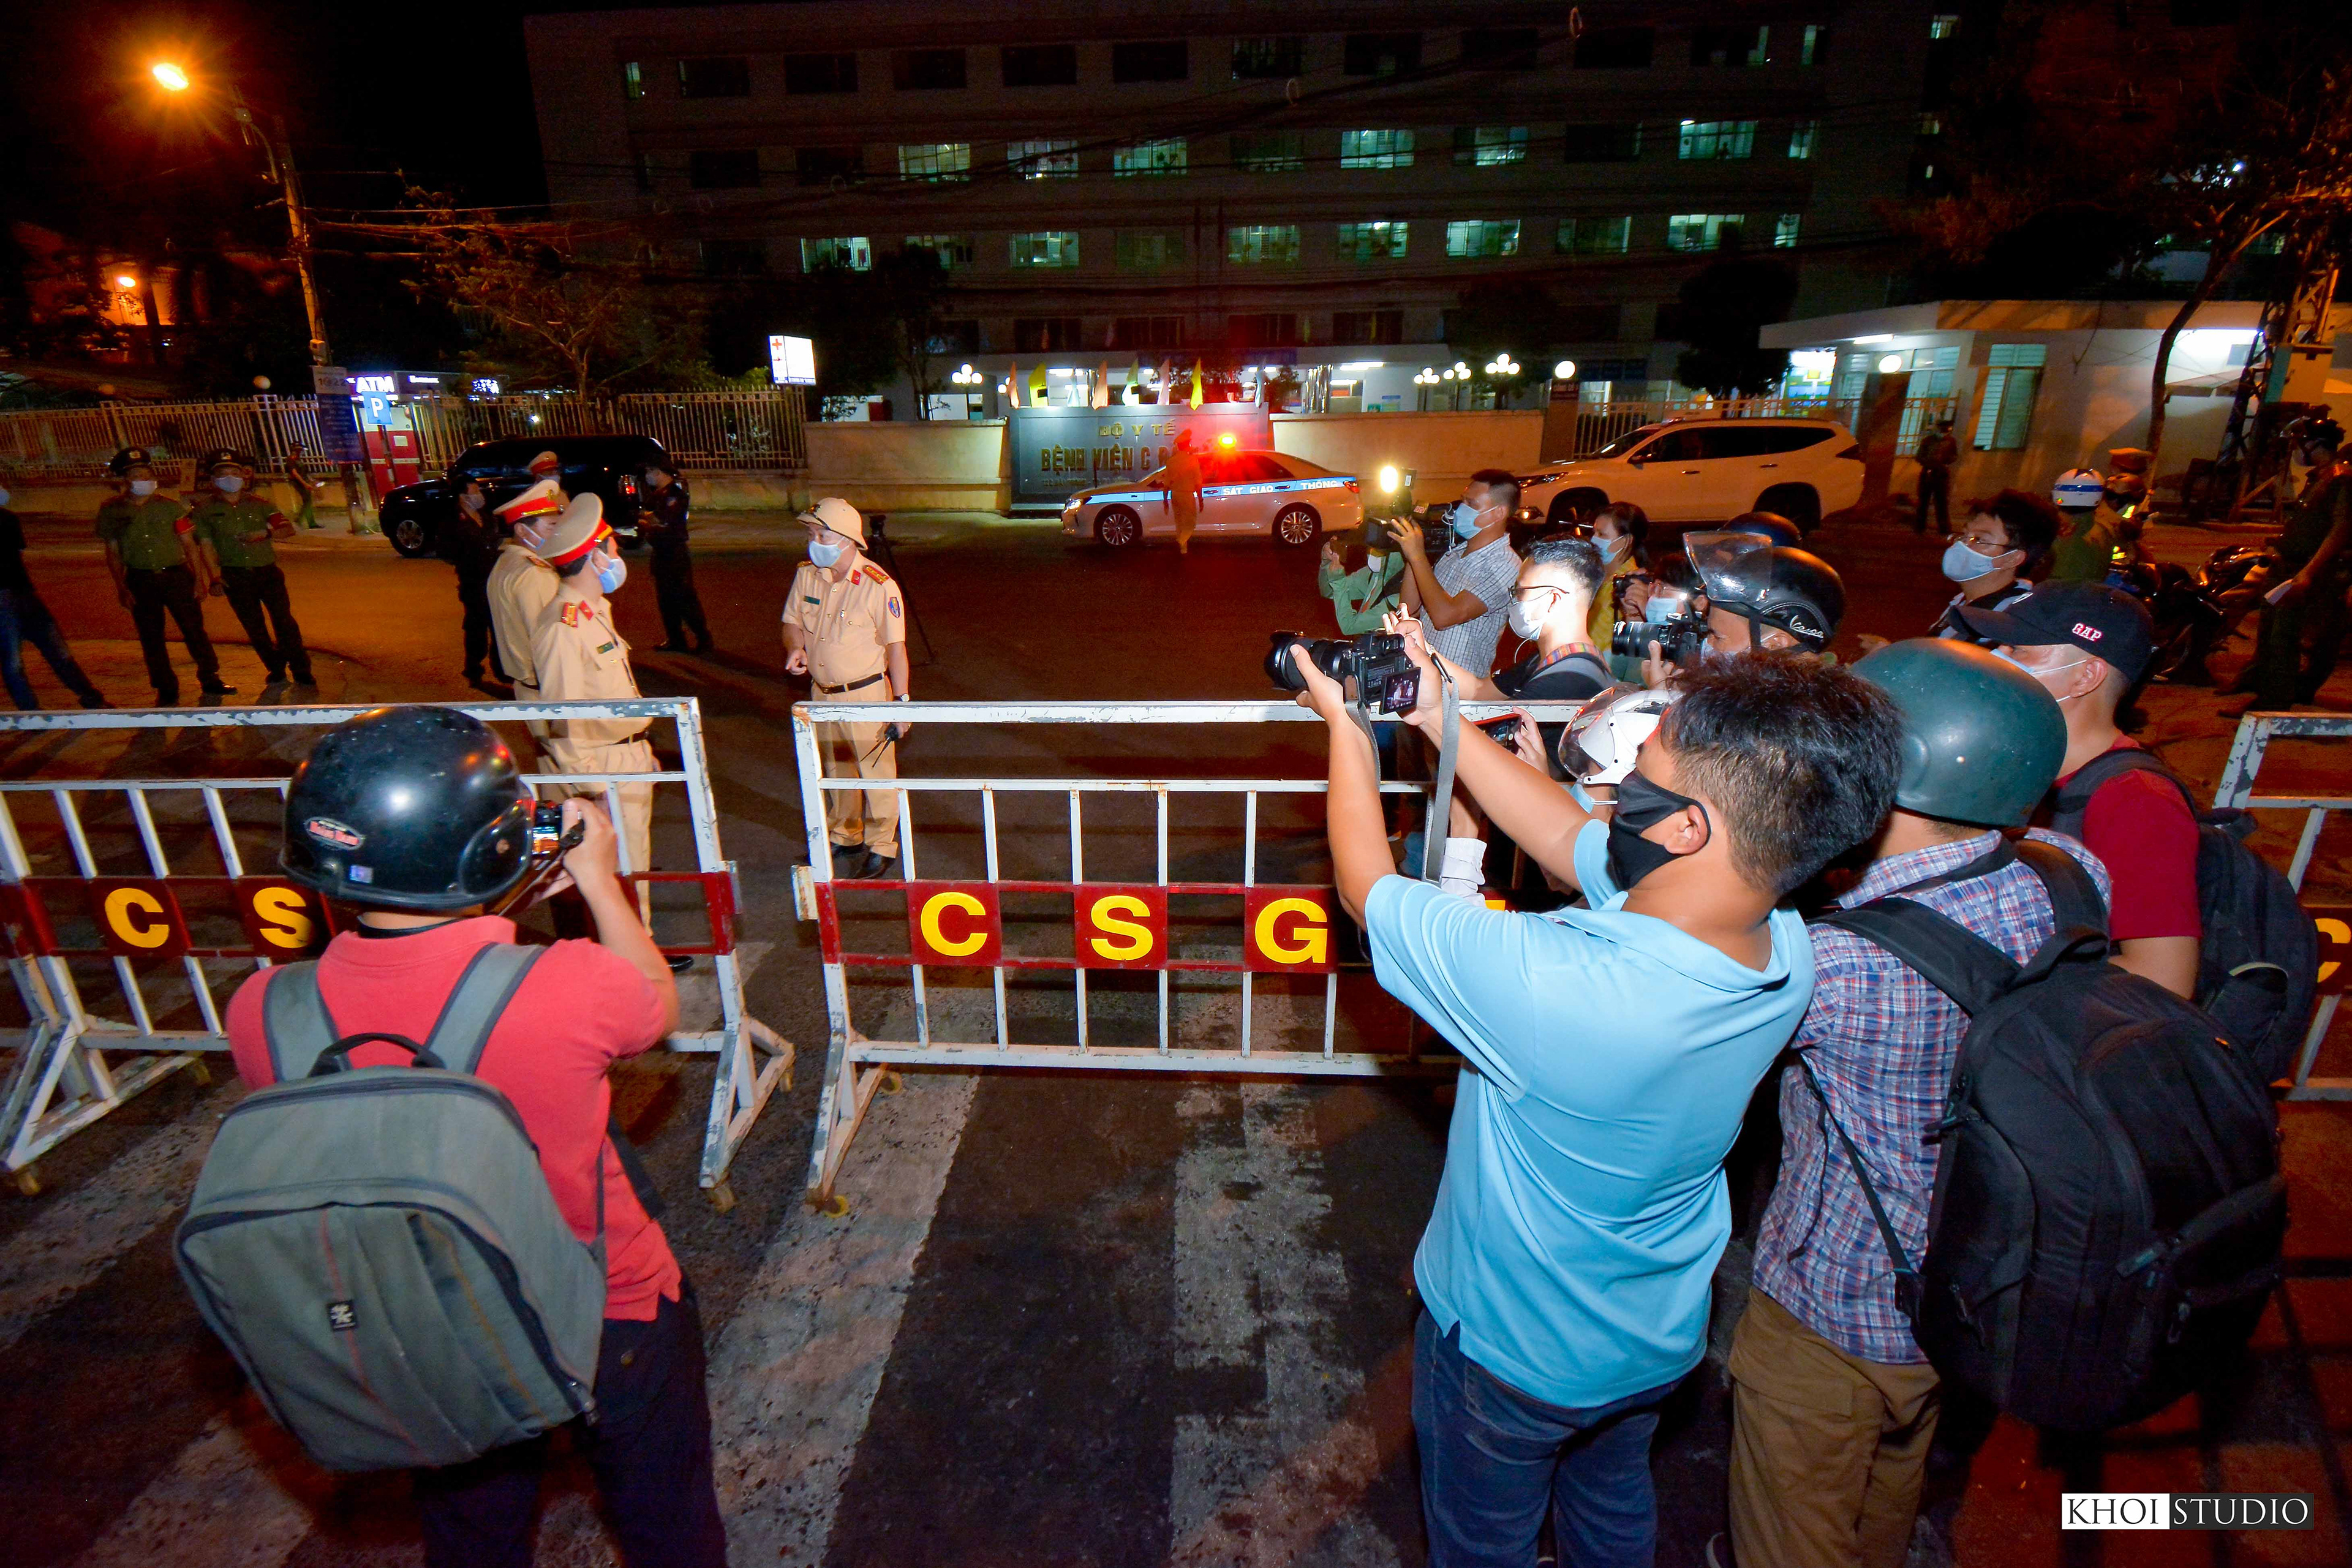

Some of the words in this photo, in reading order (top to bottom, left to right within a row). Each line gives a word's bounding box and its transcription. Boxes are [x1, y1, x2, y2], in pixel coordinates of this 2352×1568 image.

[356, 376, 395, 393] ATM
[371, 398, 384, 418] P
[1131, 424, 1144, 436] Y
[1041, 443, 1087, 476] BỆNH
[1091, 443, 1134, 475] VIỆN
[1140, 445, 1151, 471] C
[1250, 485, 1274, 494] GIAO
[1300, 480, 1338, 490] THÔNG
[2072, 623, 2102, 641] GAP
[105, 888, 170, 948] C
[252, 887, 313, 948] S
[919, 892, 988, 957] C
[1089, 894, 1153, 960] S
[1254, 897, 1327, 964] G
